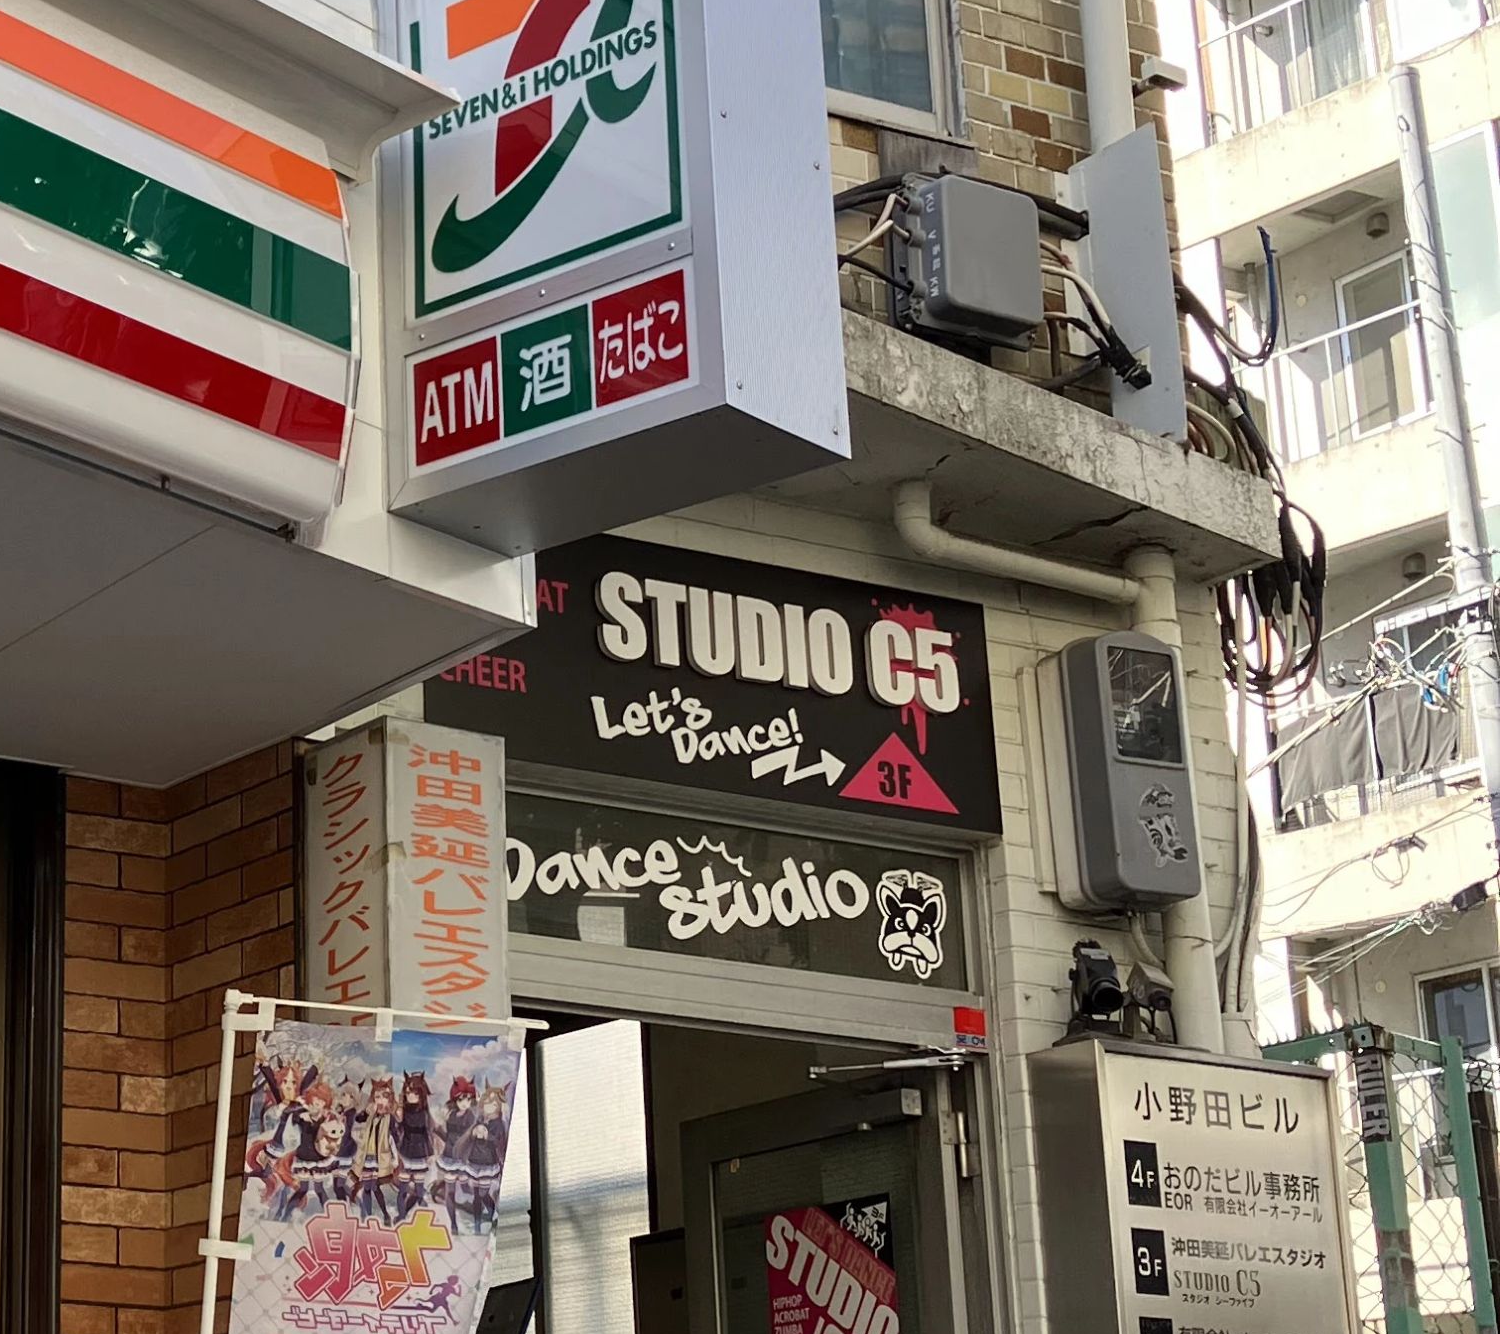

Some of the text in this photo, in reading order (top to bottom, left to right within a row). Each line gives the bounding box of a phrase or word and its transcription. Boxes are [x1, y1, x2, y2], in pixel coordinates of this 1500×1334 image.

[533, 20, 657, 95] HOLDINGS
[598, 298, 685, 385] たばこ
[519, 334, 573, 413] 酒
[421, 360, 495, 444] ATM
[596, 572, 960, 713] STUDIO C5
[590, 688, 712, 740] Let's
[671, 709, 804, 764] Dance!
[877, 761, 913, 801] 3F
[506, 835, 682, 902] Dance
[1133, 1081, 1300, 1135] 小野田ビル
[1130, 1159, 1156, 1189] 4F
[1163, 1162, 1321, 1204] おのだビル事務所
[1164, 1191, 1323, 1224] EOR 有限会社イーオーアール
[1136, 1246, 1163, 1278] 3F
[1171, 1237, 1327, 1270] 沖田美延バレエスタジオ
[772, 1293, 803, 1310] HIPHOP
[1236, 1269, 1262, 1299] C5
[773, 1308, 811, 1324] ACROBAT
